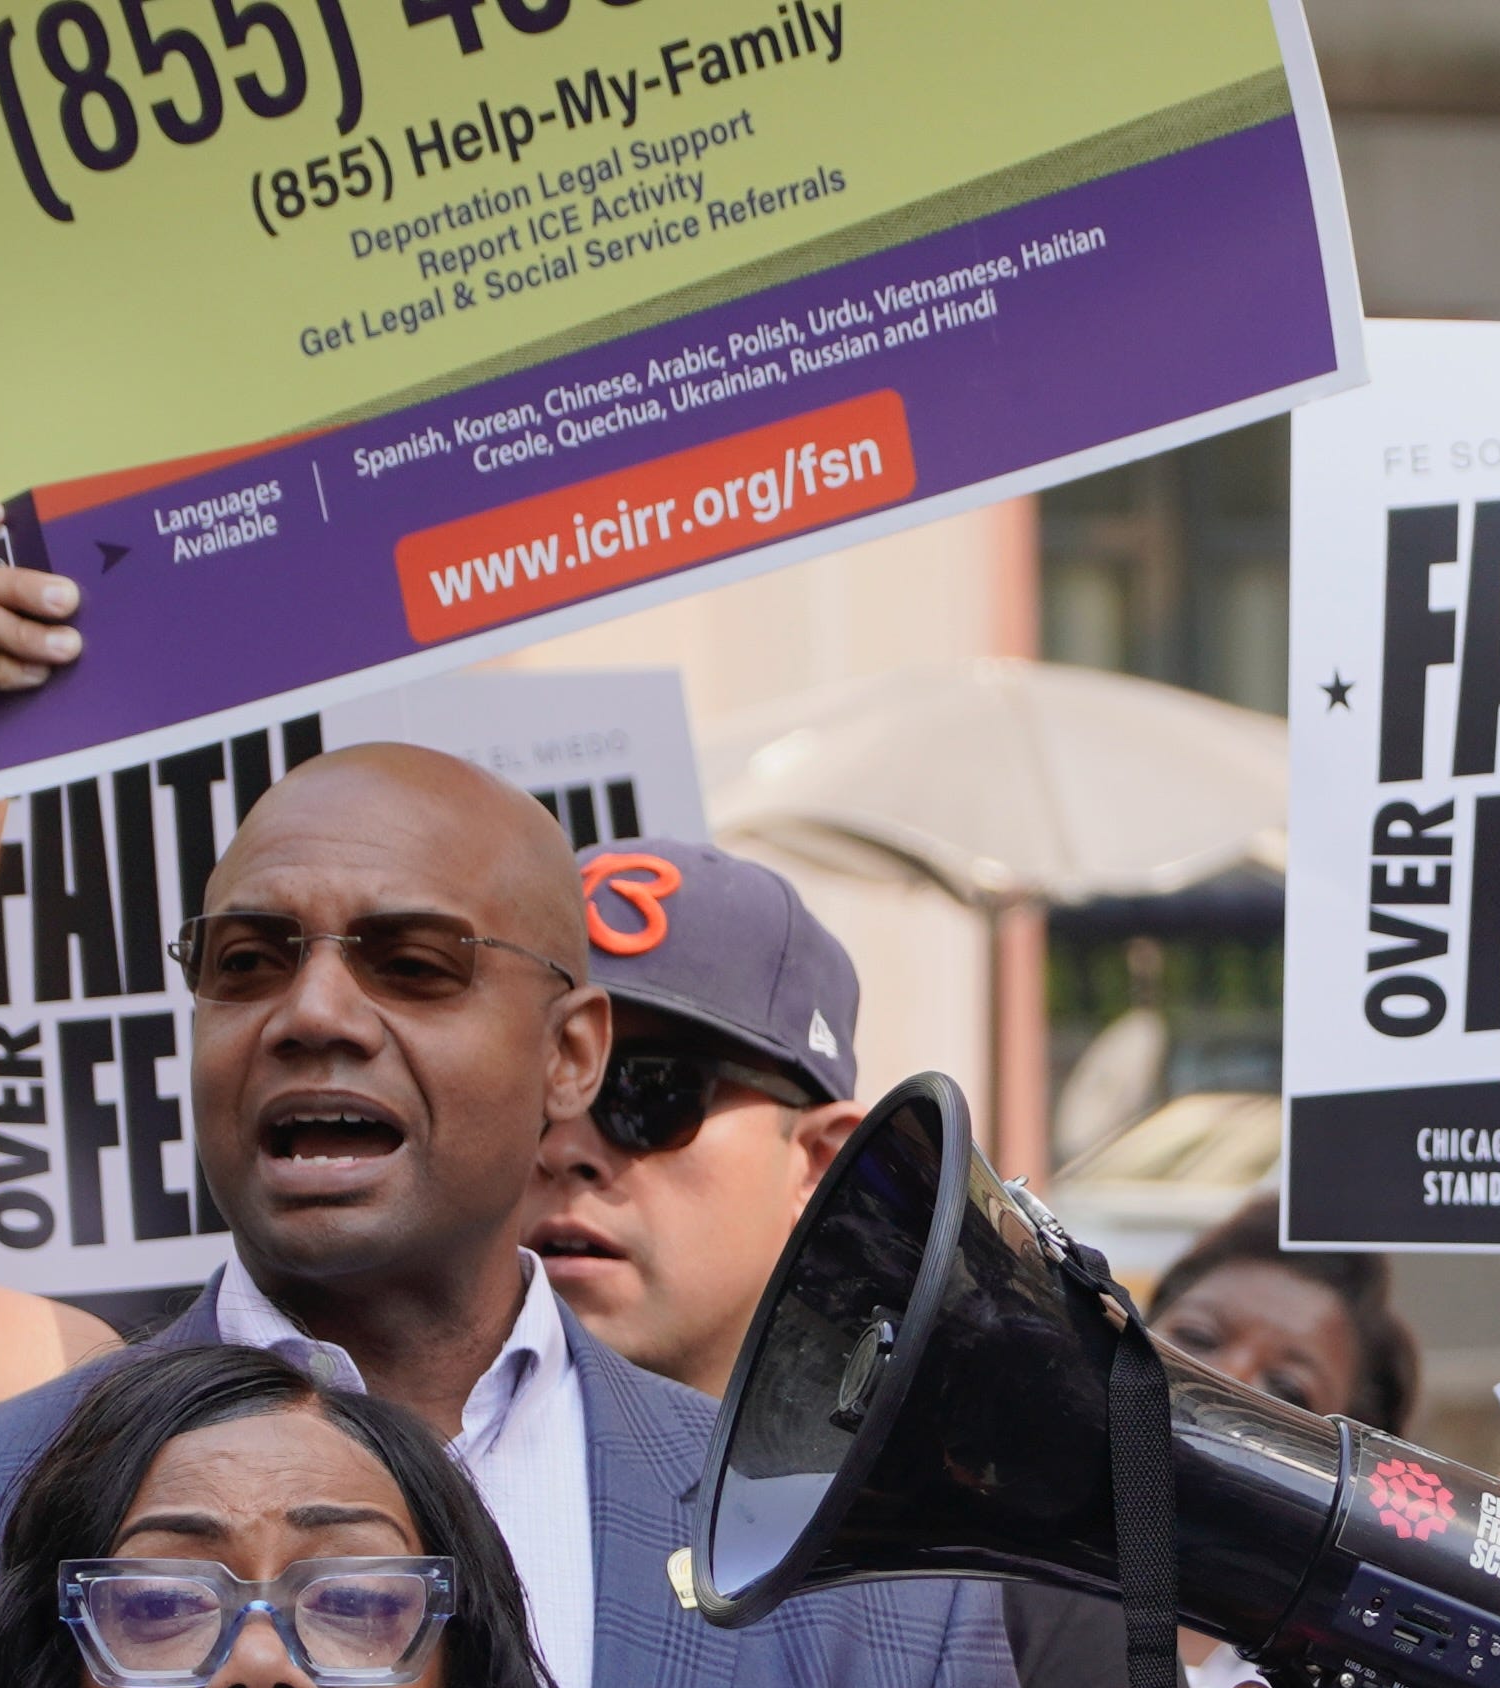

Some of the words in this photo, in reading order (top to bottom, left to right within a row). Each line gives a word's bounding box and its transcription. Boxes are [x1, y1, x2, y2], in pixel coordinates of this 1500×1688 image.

[250, 137, 395, 237] (855)
[404, 2, 846, 178] Help-My-Family
[350, 178, 532, 260] Deportation
[538, 147, 626, 203] Legal
[631, 107, 756, 178] Support
[299, 327, 357, 360] Get
[362, 295, 449, 345] Legal
[453, 280, 478, 312] &
[484, 258, 580, 304] Social
[586, 219, 703, 275] Service
[708, 165, 846, 244] Referrals
[417, 227, 519, 284] Report
[527, 209, 583, 246] ICE
[590, 172, 707, 228] Activity
[352, 430, 453, 485] Spanish,
[452, 398, 543, 457] Korean,
[543, 368, 644, 429] Chinese,
[644, 340, 727, 396] Arabic,
[727, 313, 807, 369] Polish,
[806, 298, 876, 341] Urdu,
[871, 253, 1020, 322] Vietnamese,
[1017, 222, 1108, 275] Haitian
[473, 428, 556, 478] Creole,
[555, 393, 667, 452] Quechua,
[668, 355, 789, 412] Ukrainian,
[788, 325, 881, 377] Russian
[879, 312, 930, 351] and
[931, 289, 1000, 338] Hindi
[152, 475, 284, 541] Languages
[172, 511, 280, 566] Available
[428, 432, 884, 607] www.icirr.org/fsn
[1363, 798, 1453, 1040] OVER
[1344, 1658, 1378, 1680] USB/SD
